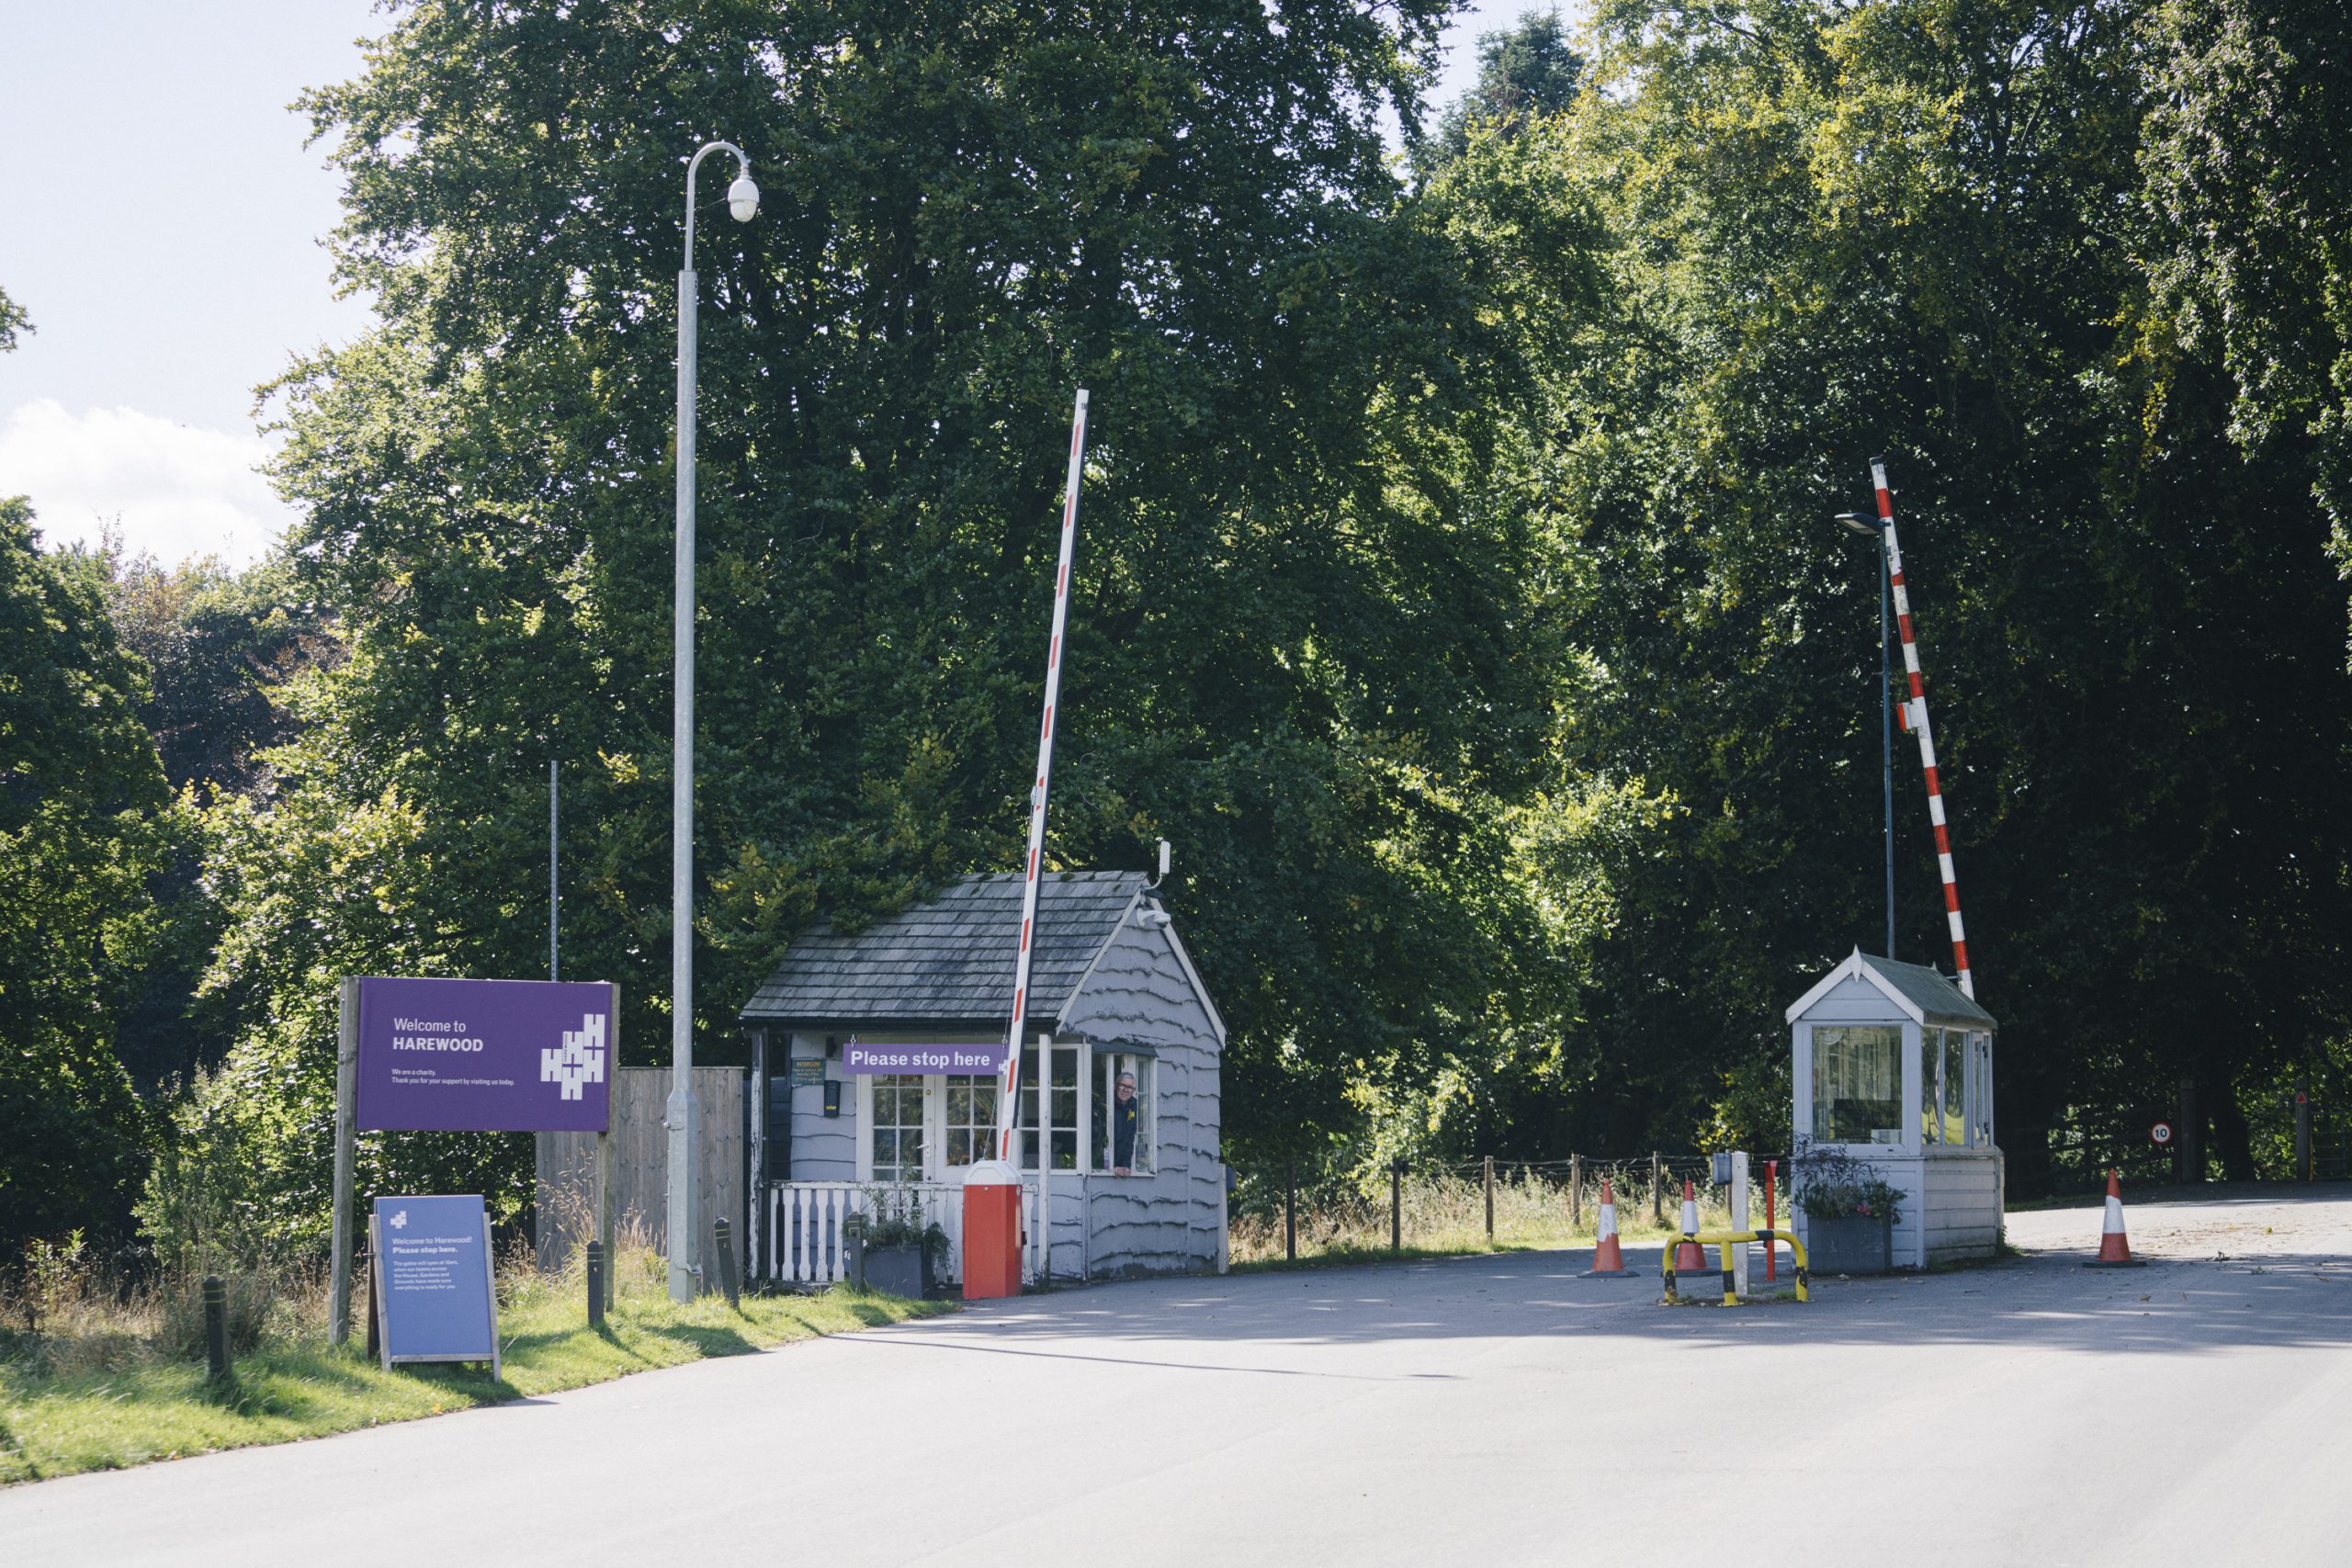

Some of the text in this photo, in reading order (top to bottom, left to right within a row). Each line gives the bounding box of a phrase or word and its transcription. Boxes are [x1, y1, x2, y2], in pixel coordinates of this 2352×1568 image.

[393, 1018, 467, 1032] Welcome to
[392, 1037, 484, 1052] HAREWOOD
[851, 1051, 990, 1069] Please stop here
[416, 1068, 436, 1077] charity.
[442, 1077, 463, 1086] support
[463, 1077, 469, 1086] by
[499, 1078, 514, 1087] today.
[2154, 1128, 2167, 1138] 10
[420, 1247, 437, 1255] stop
